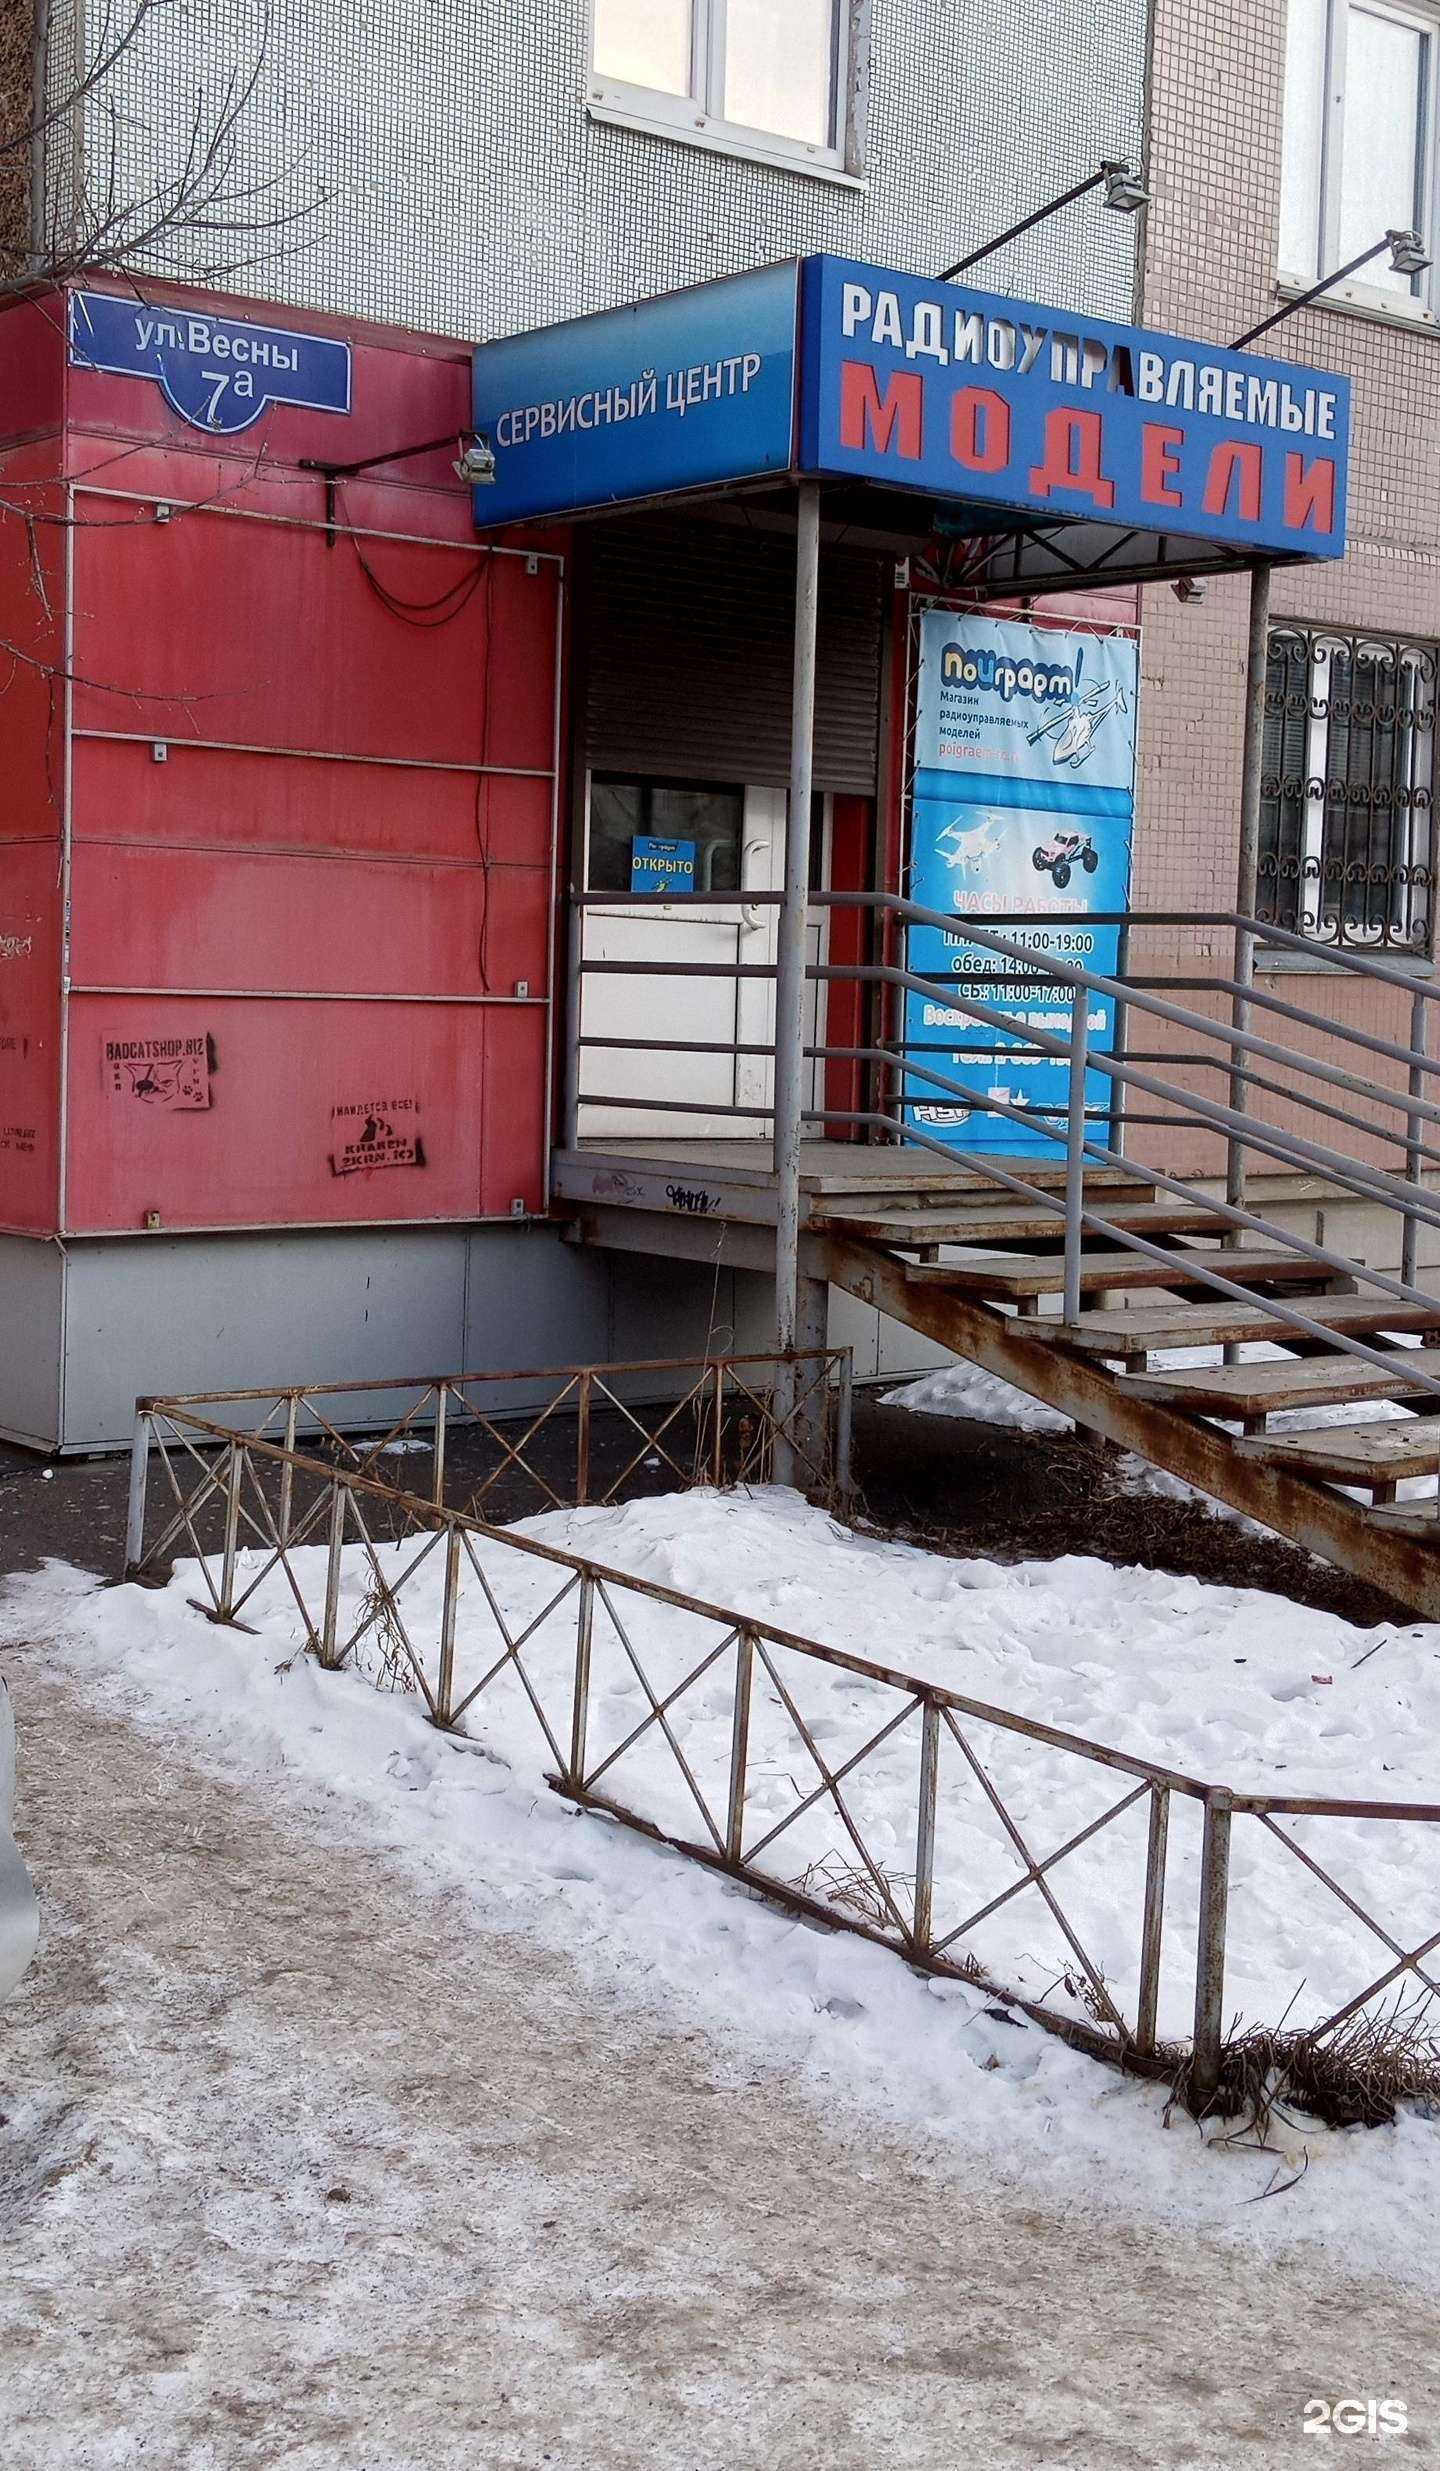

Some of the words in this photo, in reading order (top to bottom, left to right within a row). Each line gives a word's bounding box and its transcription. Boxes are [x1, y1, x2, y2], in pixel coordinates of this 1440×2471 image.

[842, 282, 1336, 440] РАДИОУПРАВЛЯЕМЫЕ
[496, 369, 657, 448] СЕРВИСНЫЙ
[666, 353, 761, 416] ЦЕНТР
[840, 359, 1335, 534] МОДЕЛИ
[940, 691, 979, 705] Магазин
[939, 708, 1030, 730] радиоуправляемых
[939, 727, 981, 740] моделей
[632, 856, 693, 874] ОТКРЫТО
[954, 890, 1007, 913] ЧАСЫ
[1011, 896, 1088, 913] РАБОТЫ
[1011, 931, 1093, 952] 11:00-19:00
[953, 953, 996, 975] обед:
[106, 1038, 204, 1060] BADCATSHOP.BIZ
